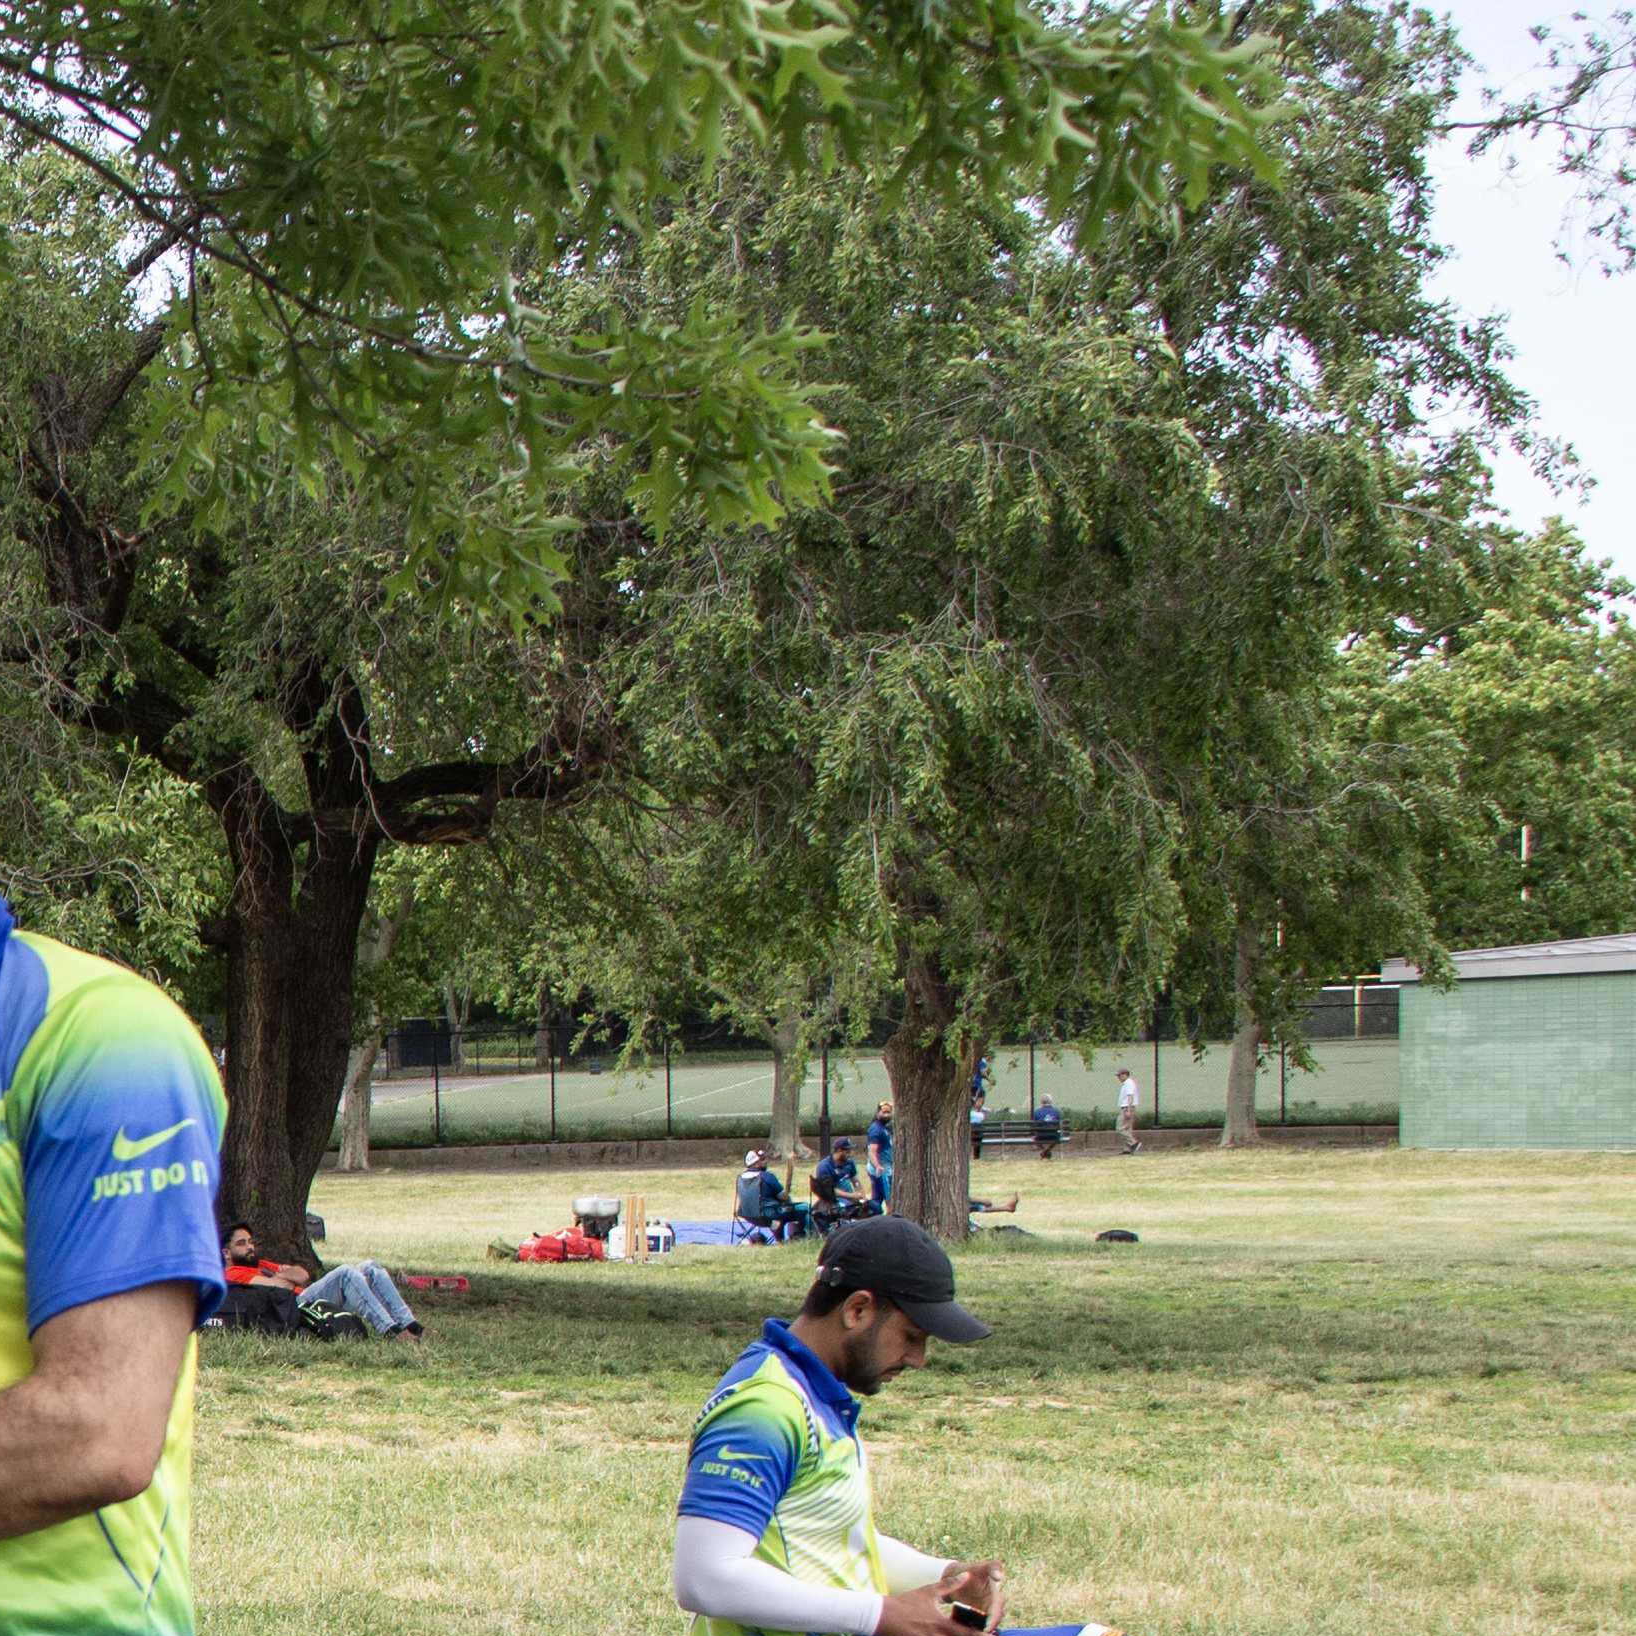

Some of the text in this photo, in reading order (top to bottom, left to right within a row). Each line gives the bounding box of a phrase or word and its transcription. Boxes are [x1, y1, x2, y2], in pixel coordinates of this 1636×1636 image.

[91, 1168, 145, 1203] JUST
[150, 1162, 186, 1193] DO
[699, 1461, 730, 1477] JUST
[730, 1466, 749, 1483] DO
